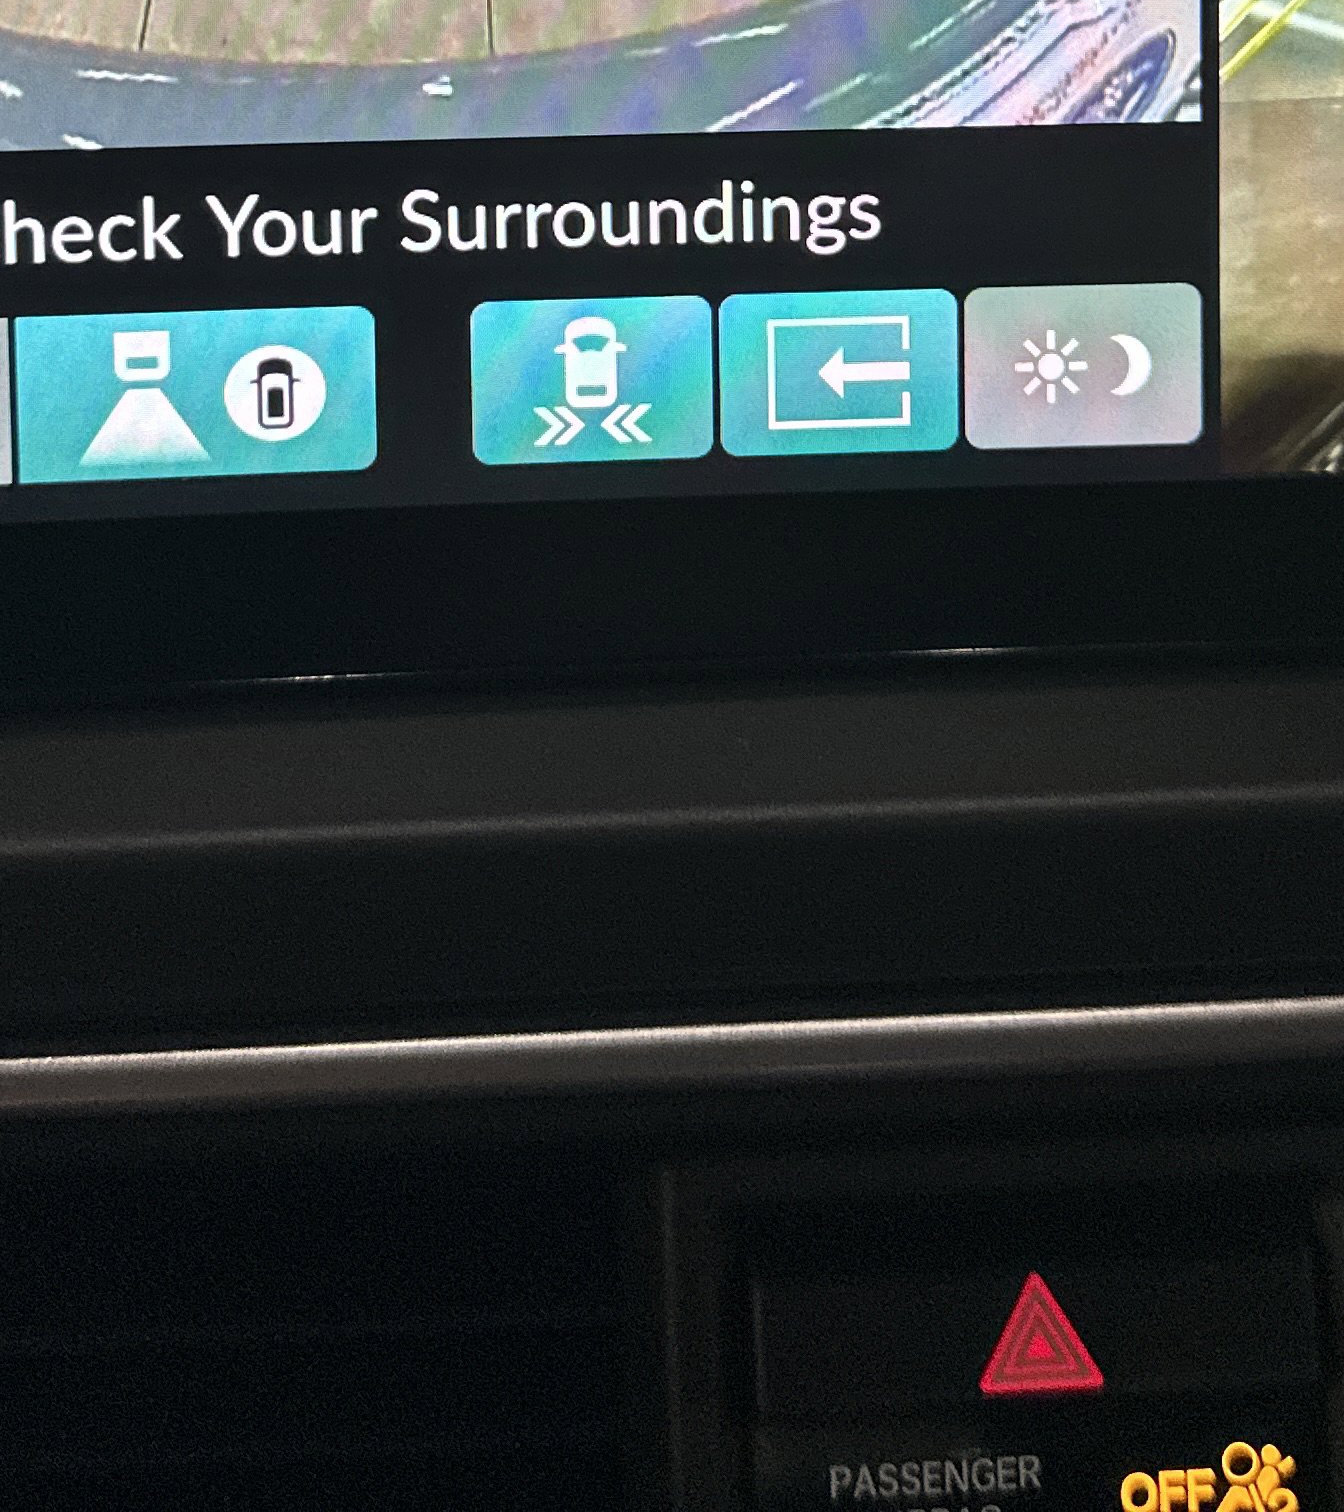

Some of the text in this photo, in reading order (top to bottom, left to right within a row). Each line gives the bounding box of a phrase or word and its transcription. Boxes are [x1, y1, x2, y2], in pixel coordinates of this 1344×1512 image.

[205, 193, 378, 258] Your
[400, 179, 882, 255] Surroundings
[829, 1454, 1042, 1499] PASSENGER
[1120, 1467, 1216, 1512] OFF
